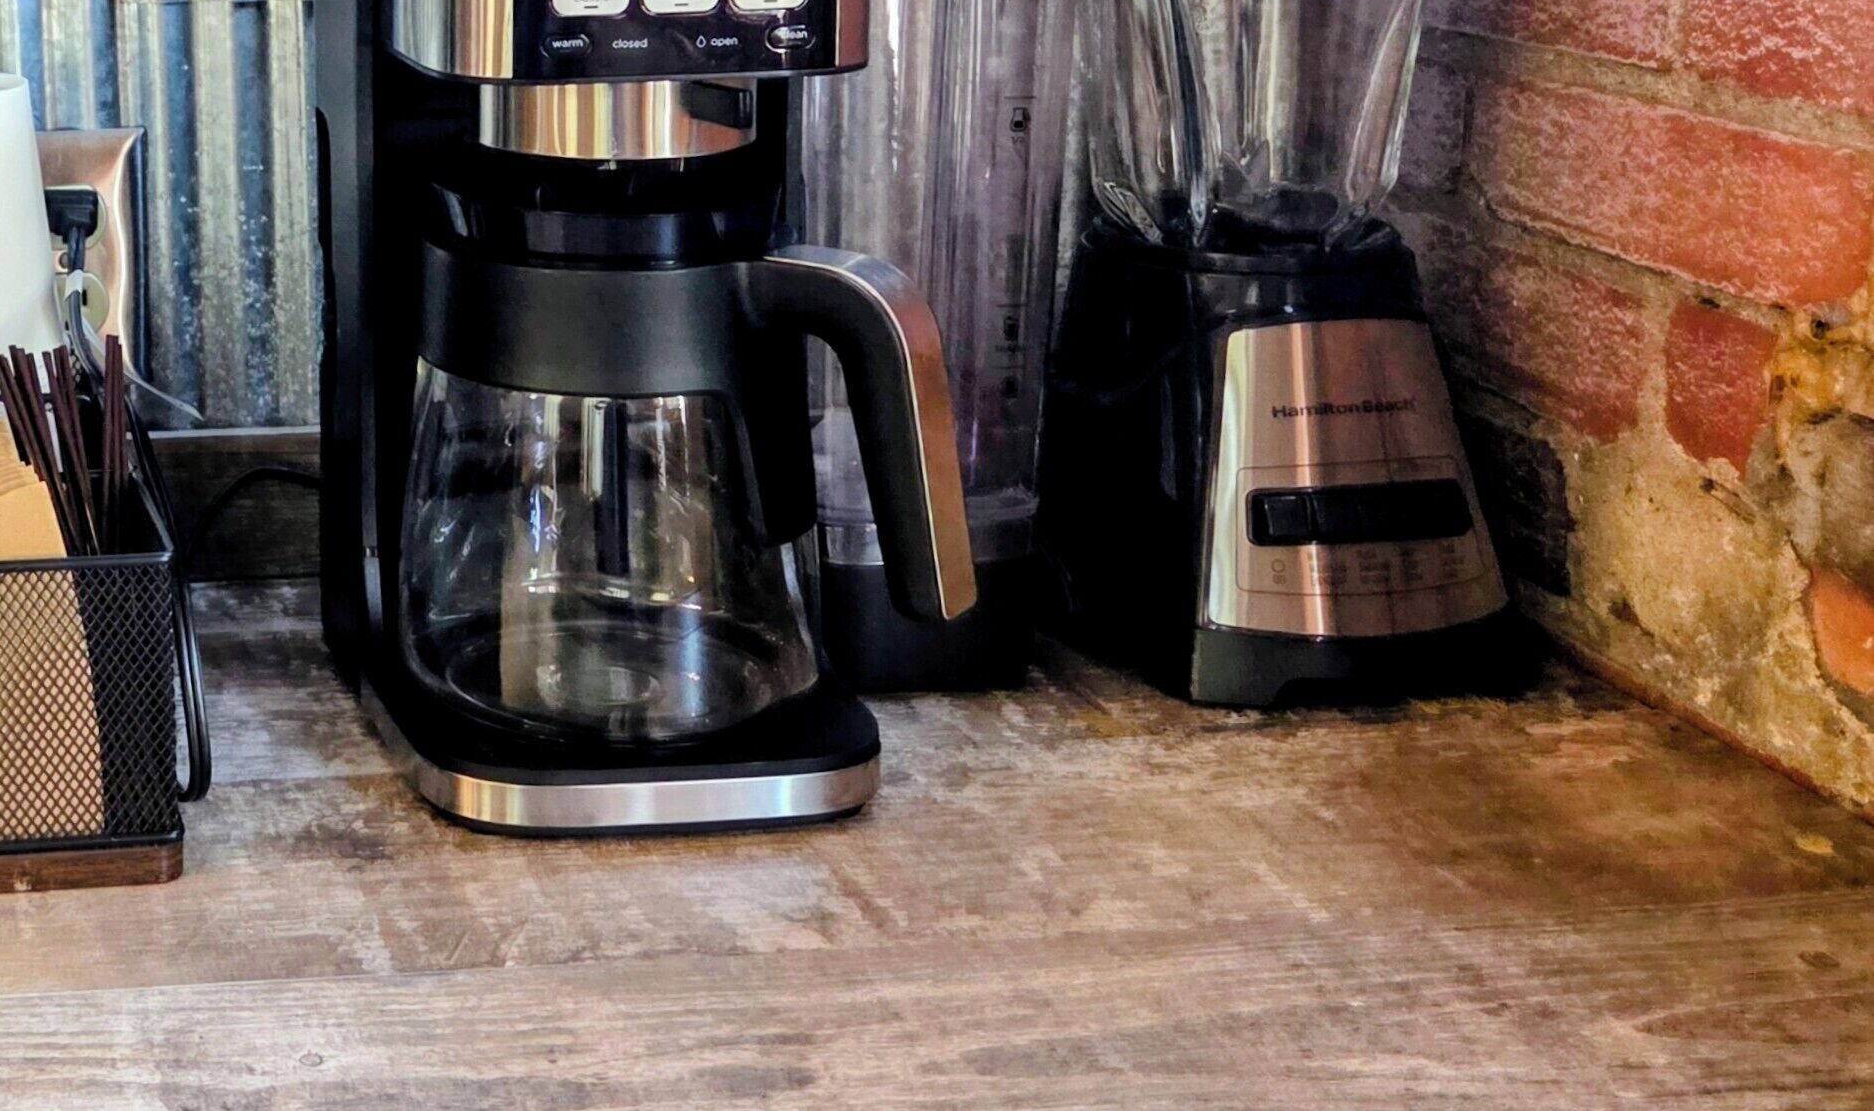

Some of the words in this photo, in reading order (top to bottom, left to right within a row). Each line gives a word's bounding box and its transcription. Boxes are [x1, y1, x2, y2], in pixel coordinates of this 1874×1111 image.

[552, 37, 584, 49] warm
[612, 37, 649, 49] closed
[710, 36, 739, 49] open
[1271, 403, 1359, 418] Hamilton
[1361, 399, 1416, 413] Beach
